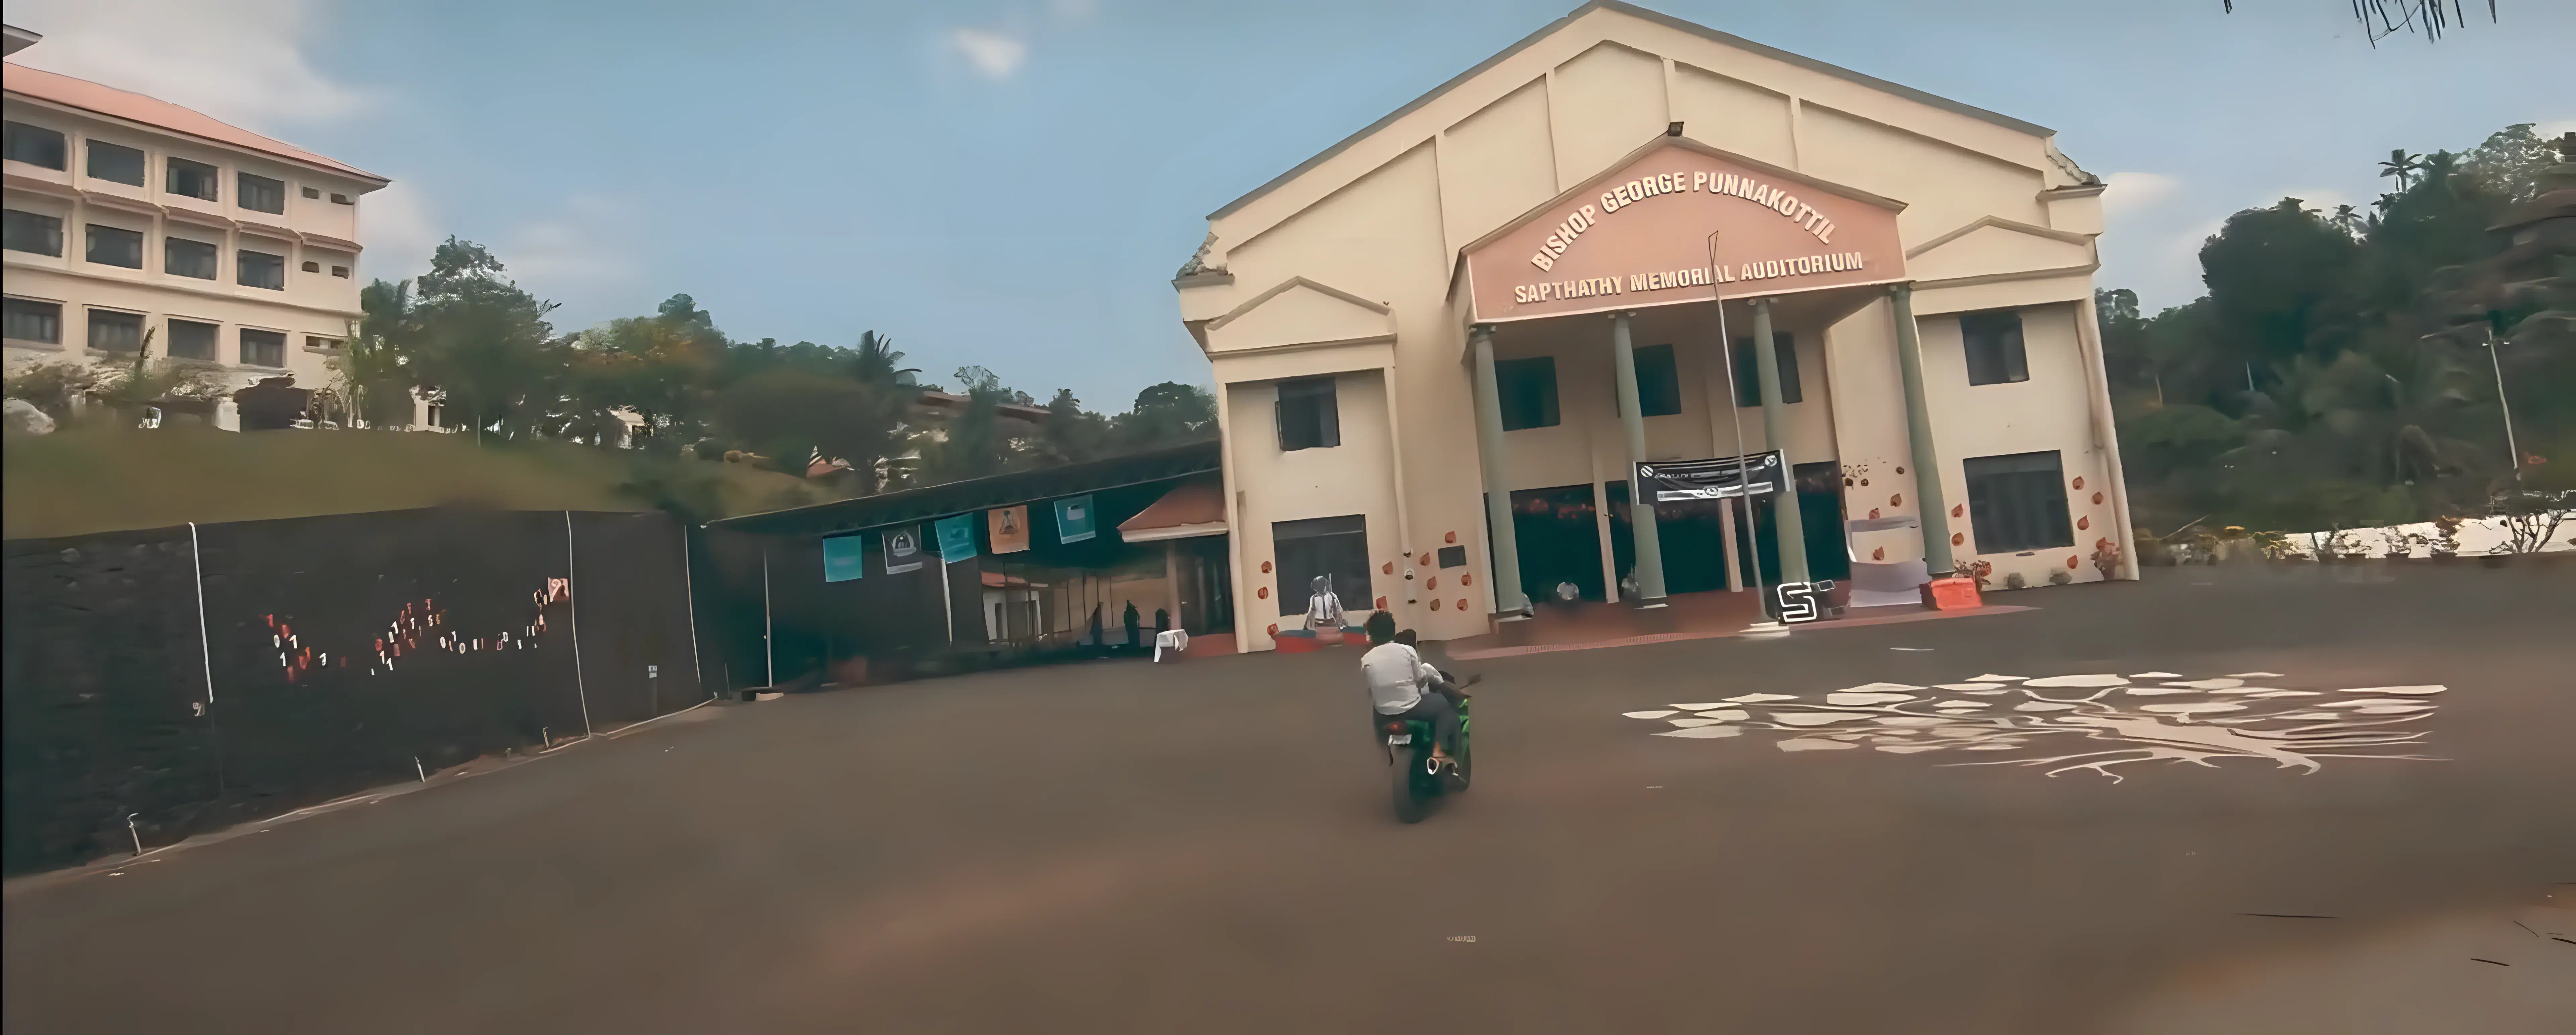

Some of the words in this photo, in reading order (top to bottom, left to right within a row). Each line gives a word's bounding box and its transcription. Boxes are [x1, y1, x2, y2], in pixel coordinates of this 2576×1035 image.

[1531, 204, 1595, 272] BISHOP
[1600, 172, 1685, 213] GEORGE
[1693, 172, 1835, 244] PUNNAKOTTIL
[1515, 276, 1622, 303] SAPTHATHY
[1630, 265, 1735, 292] MEMORIAL
[1740, 252, 1863, 281] AUDITORIUM
